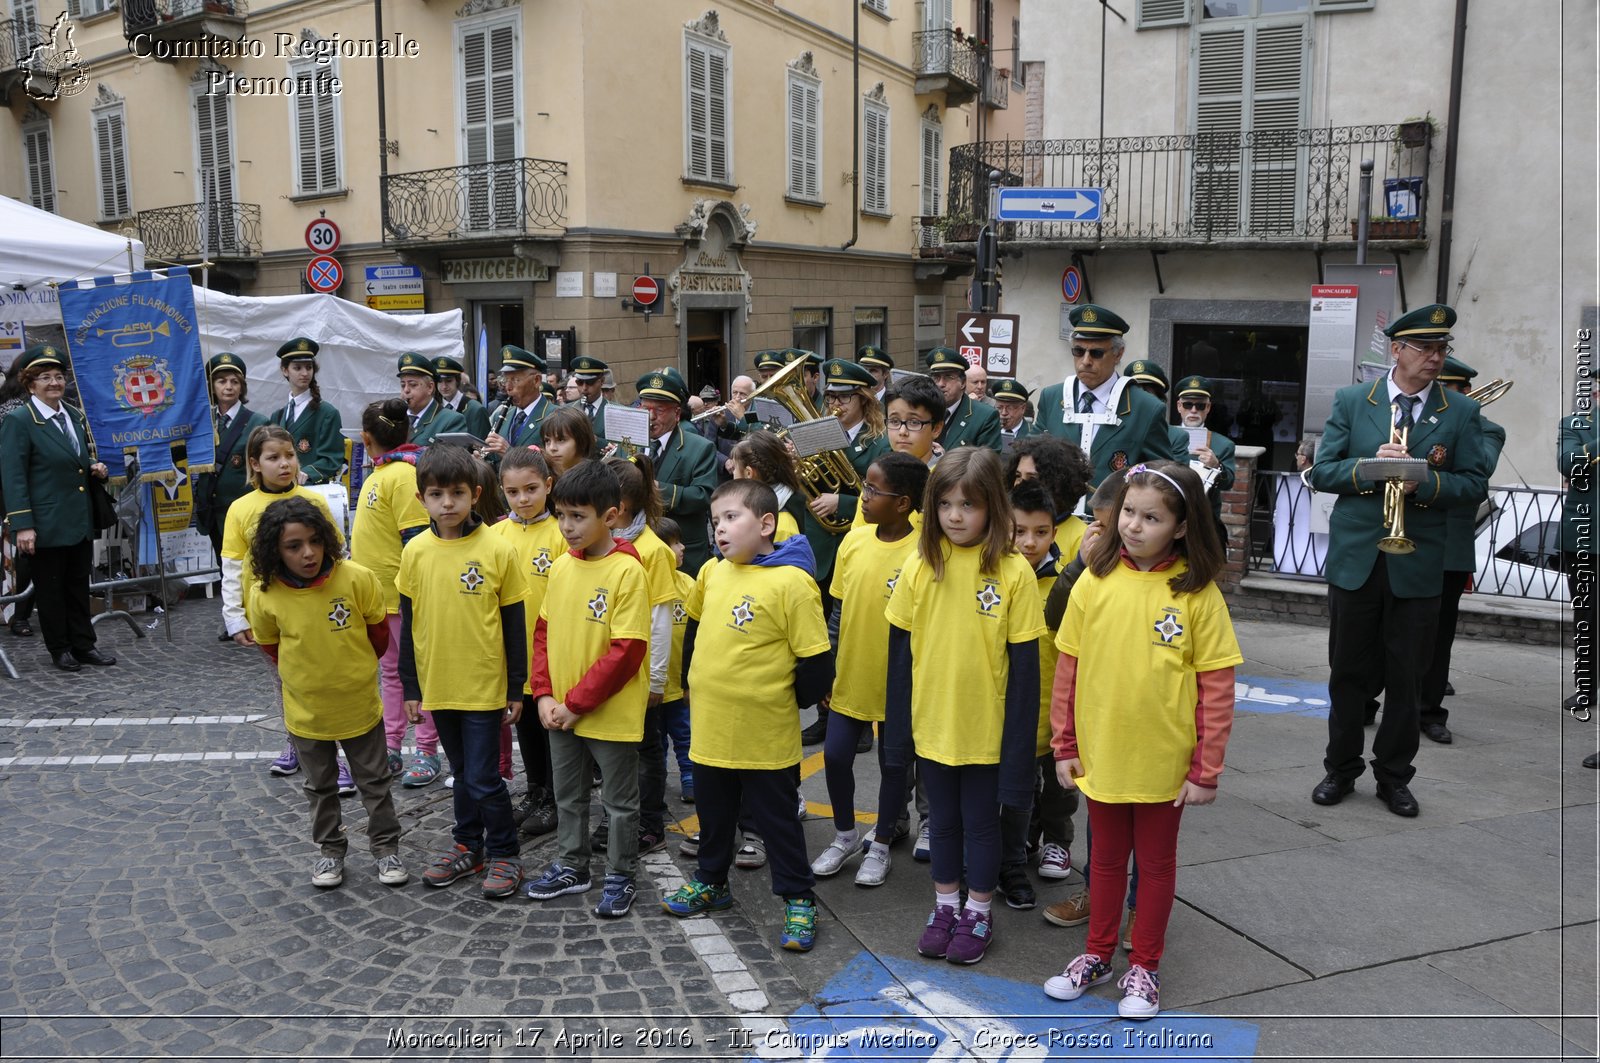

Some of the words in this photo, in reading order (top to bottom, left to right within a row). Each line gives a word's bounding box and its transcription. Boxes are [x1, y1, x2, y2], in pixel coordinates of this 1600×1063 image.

[313, 228, 333, 245] 30
[441, 257, 547, 281] PASTICCERIA
[680, 274, 743, 292] PASTICCERIA
[74, 296, 129, 346] ASSOCIAZIONE
[131, 294, 192, 334] FILARMONICA
[123, 322, 151, 333] AFM
[111, 423, 193, 444] MONCALIERI
